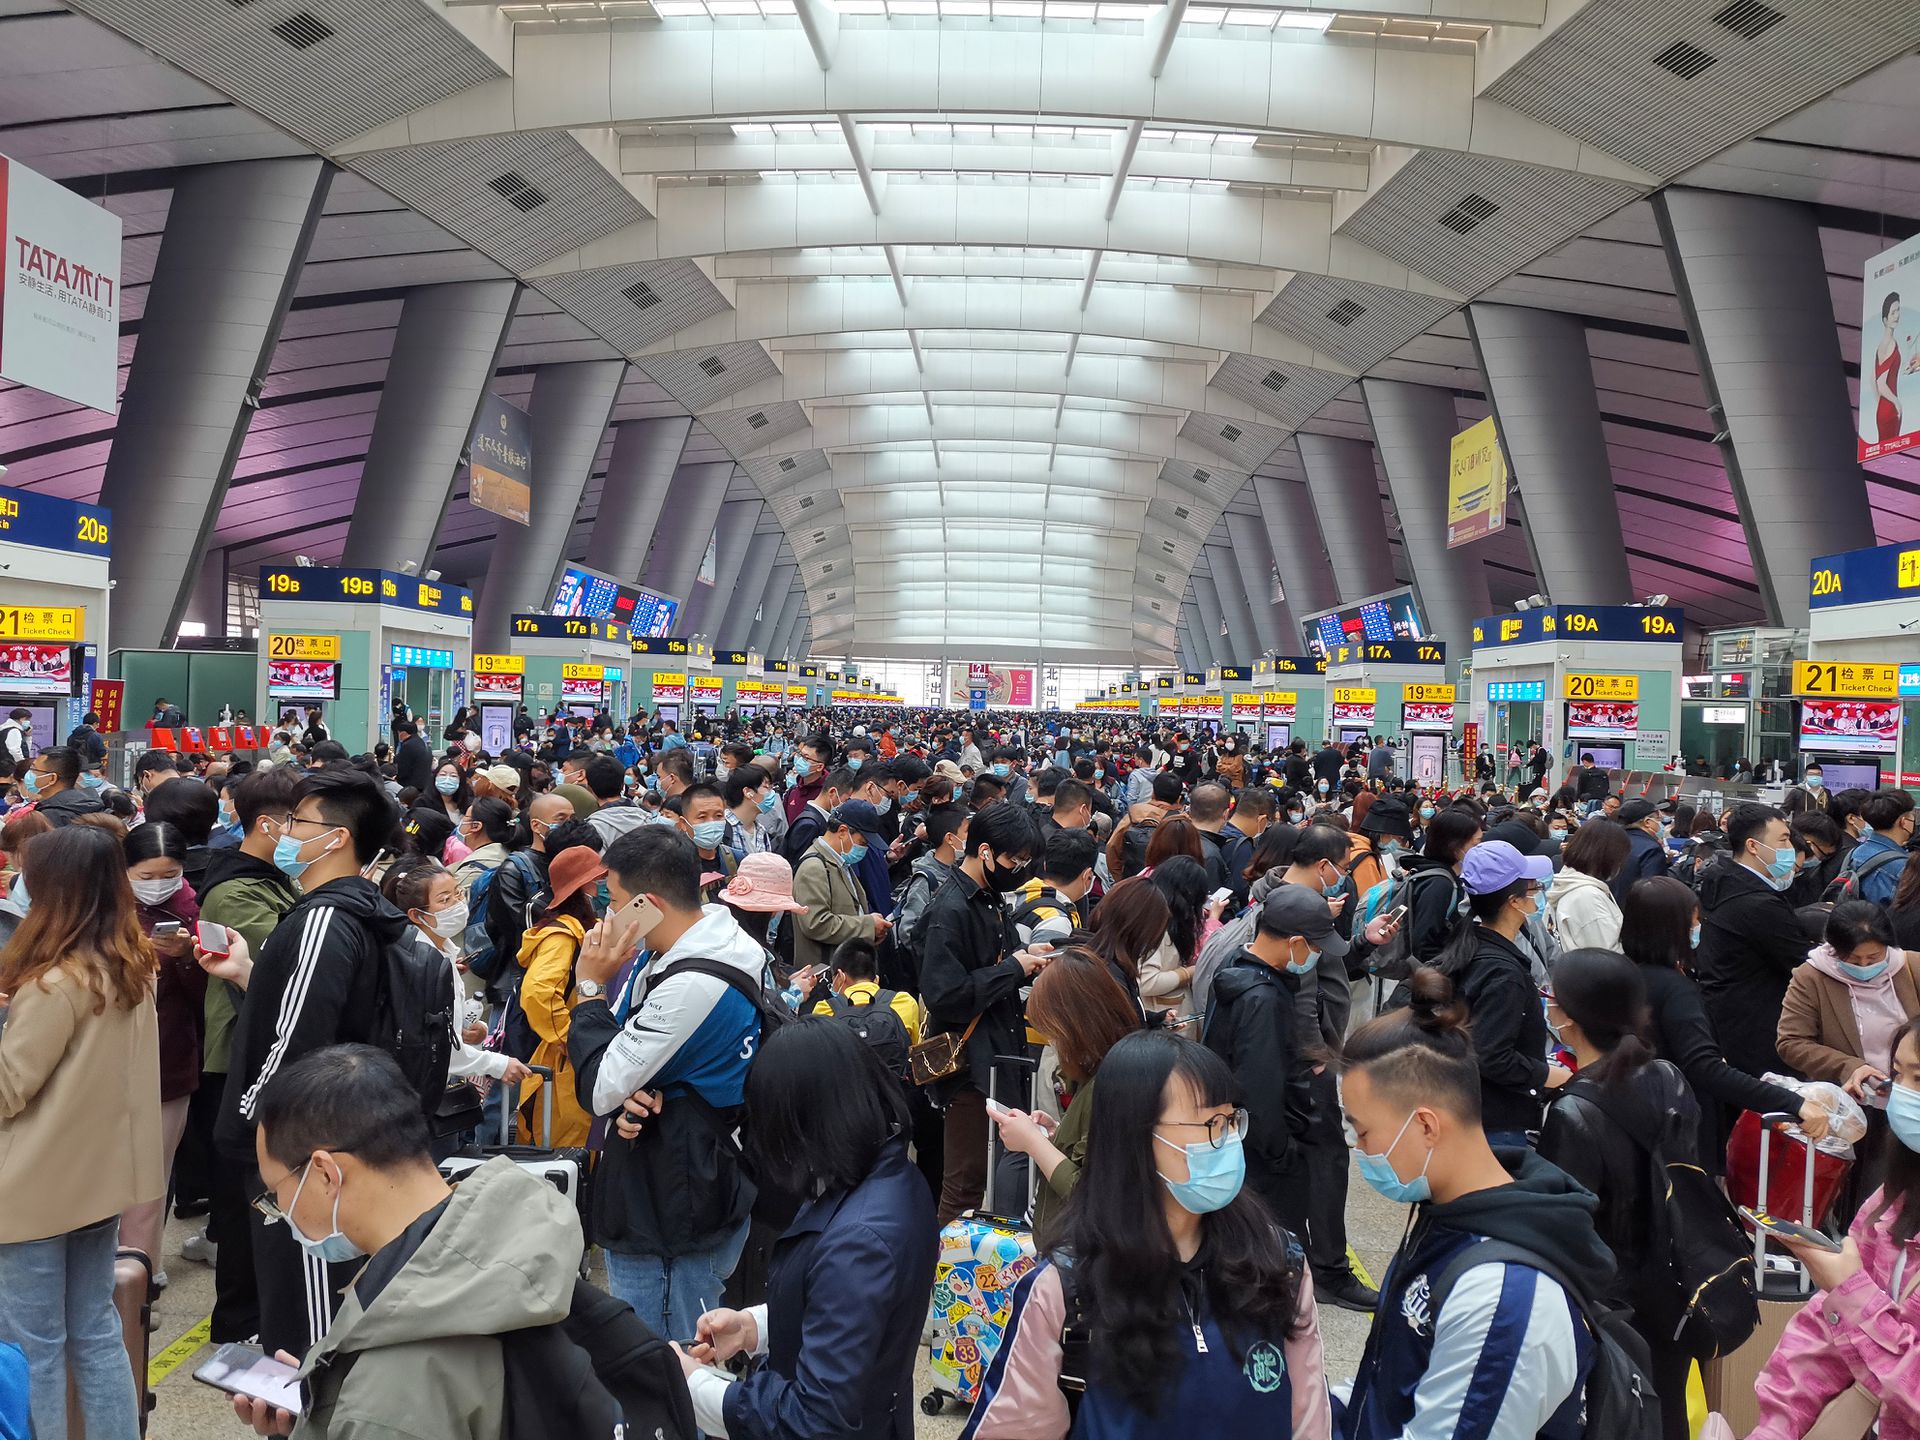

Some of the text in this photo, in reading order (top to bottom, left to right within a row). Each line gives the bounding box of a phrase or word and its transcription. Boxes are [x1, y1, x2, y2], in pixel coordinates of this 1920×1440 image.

[15, 235, 113, 307] TATA木门
[77, 515, 108, 544] 20B
[267, 574, 374, 594] 19B 19B
[381, 578, 397, 597] 19B
[1812, 569, 1842, 595] 20A
[24, 611, 72, 624] 检票口
[1542, 615, 1556, 632] 19A
[1563, 613, 1676, 634] 19A 19A
[23, 627, 71, 635] Ticket Check
[515, 619, 538, 632] 17B
[564, 620, 587, 634] 17B
[272, 636, 331, 656] 20 检票口
[667, 641, 685, 652] 15B
[1367, 645, 1441, 660] 17A 17A
[476, 656, 493, 670] 19
[1278, 659, 1327, 671] 15A 15
[564, 665, 578, 677] 18
[654, 674, 665, 683] 17
[1805, 664, 1837, 692] 21
[1841, 667, 1894, 681] 检票口
[695, 678, 705, 686] 16
[1570, 676, 1634, 696] 20 检票口
[1840, 683, 1893, 693] Ticket Check
[1233, 694, 1244, 703] 16
[1265, 693, 1276, 702] 17
[1336, 689, 1350, 701] 18
[1407, 685, 1424, 700] 19
[649, 1002, 662, 1010] NIKE
[979, 1273, 998, 1288] 22
[958, 1345, 976, 1361] 33
